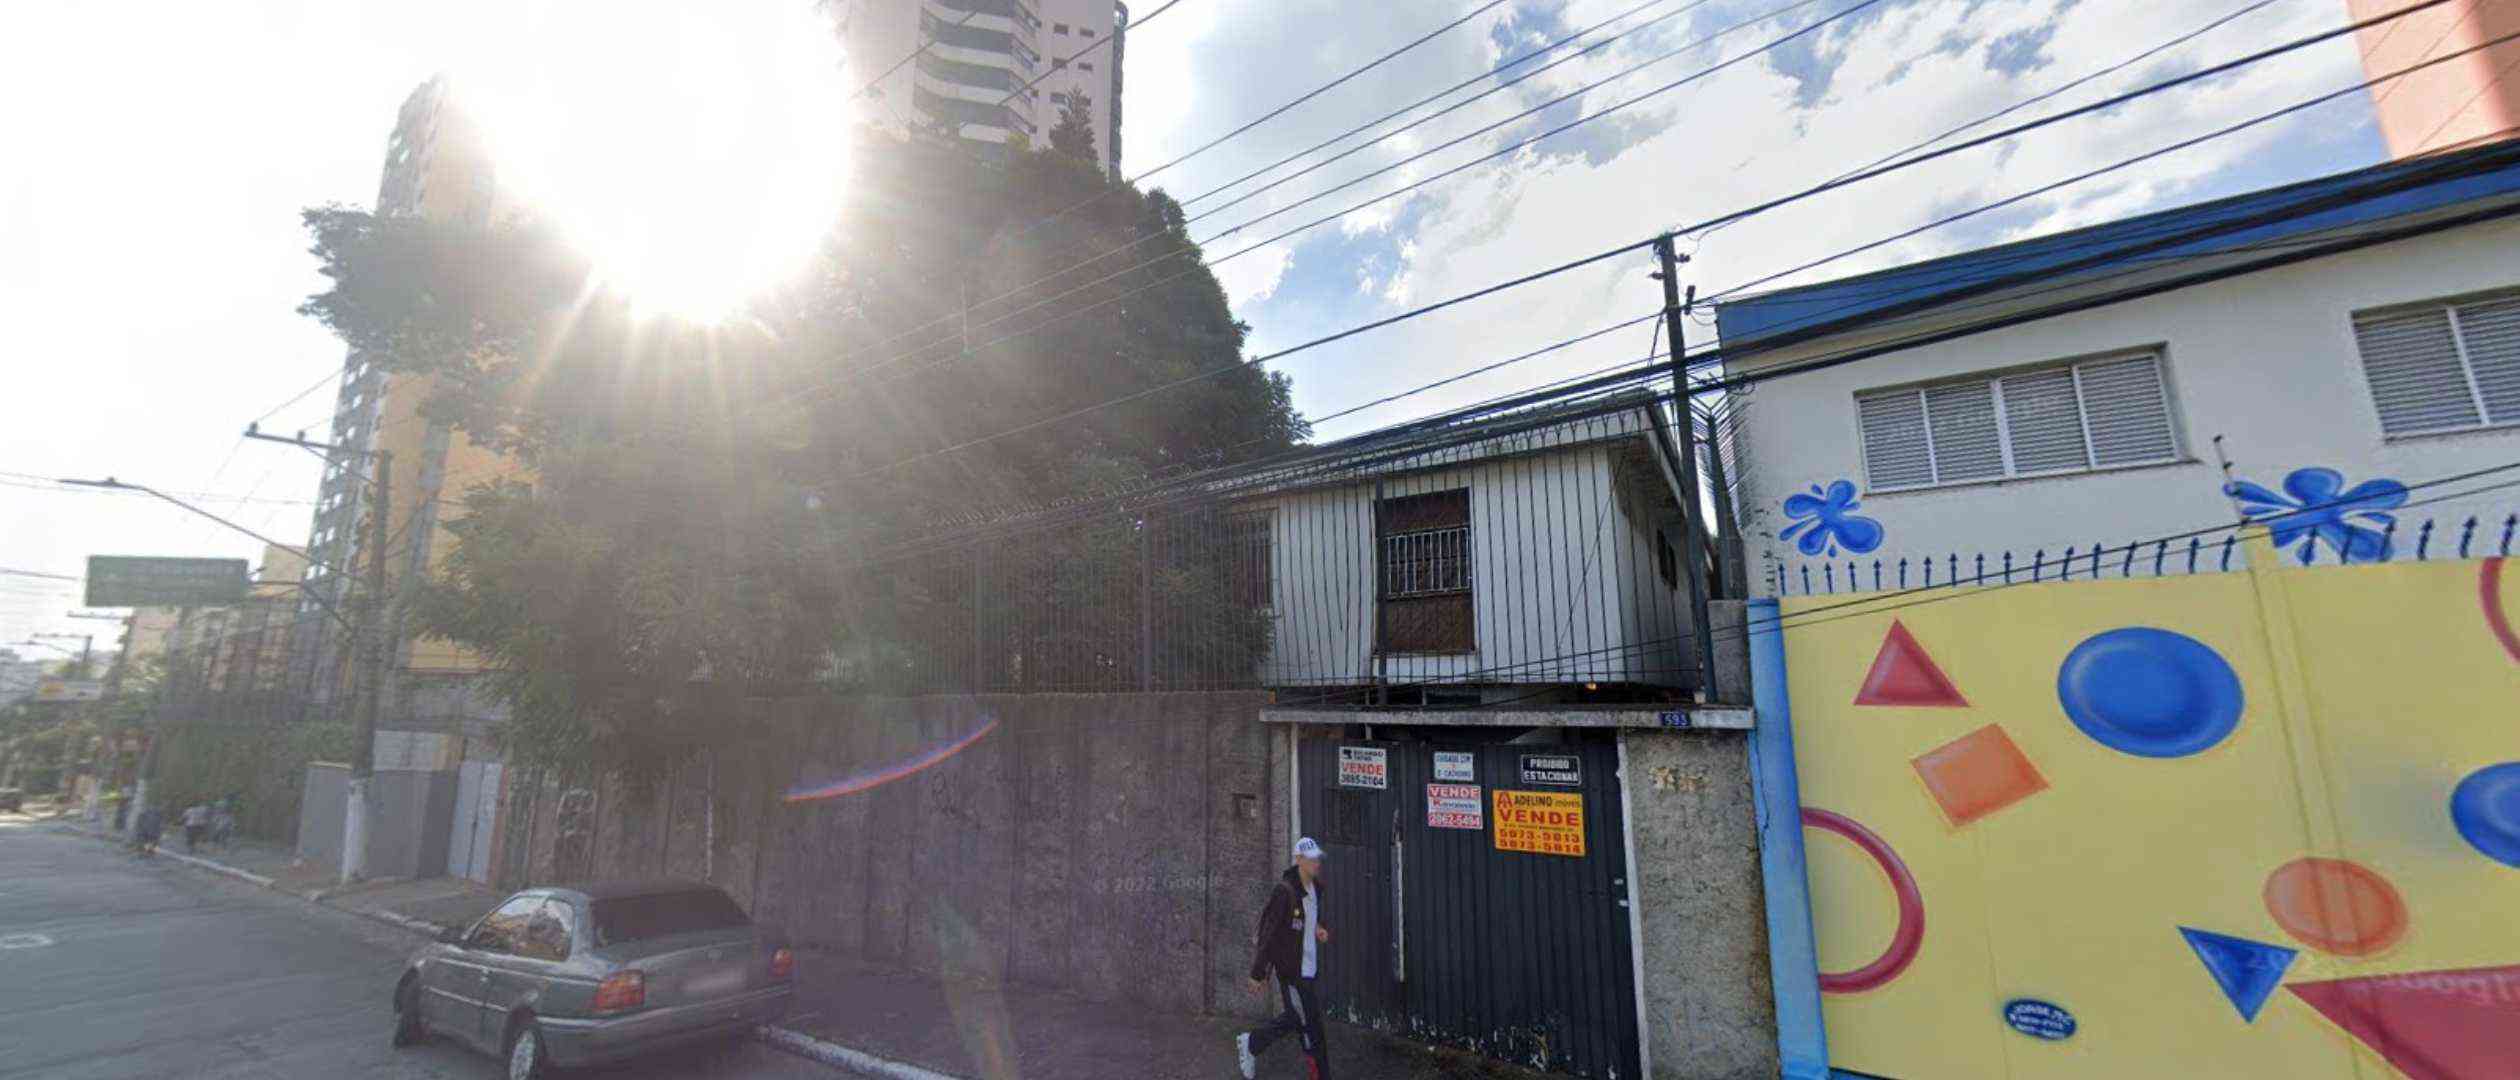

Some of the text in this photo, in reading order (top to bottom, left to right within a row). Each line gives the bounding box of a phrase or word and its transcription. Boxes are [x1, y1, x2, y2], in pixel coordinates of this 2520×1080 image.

[1343, 761, 1384, 776] VENDE
[1530, 758, 1570, 769] PROIBIDO
[1523, 770, 1579, 781] ESTACIONAR
[1430, 786, 1480, 799] VENDE
[1514, 795, 1552, 807] ADELINO
[1500, 808, 1580, 827] VENDE
